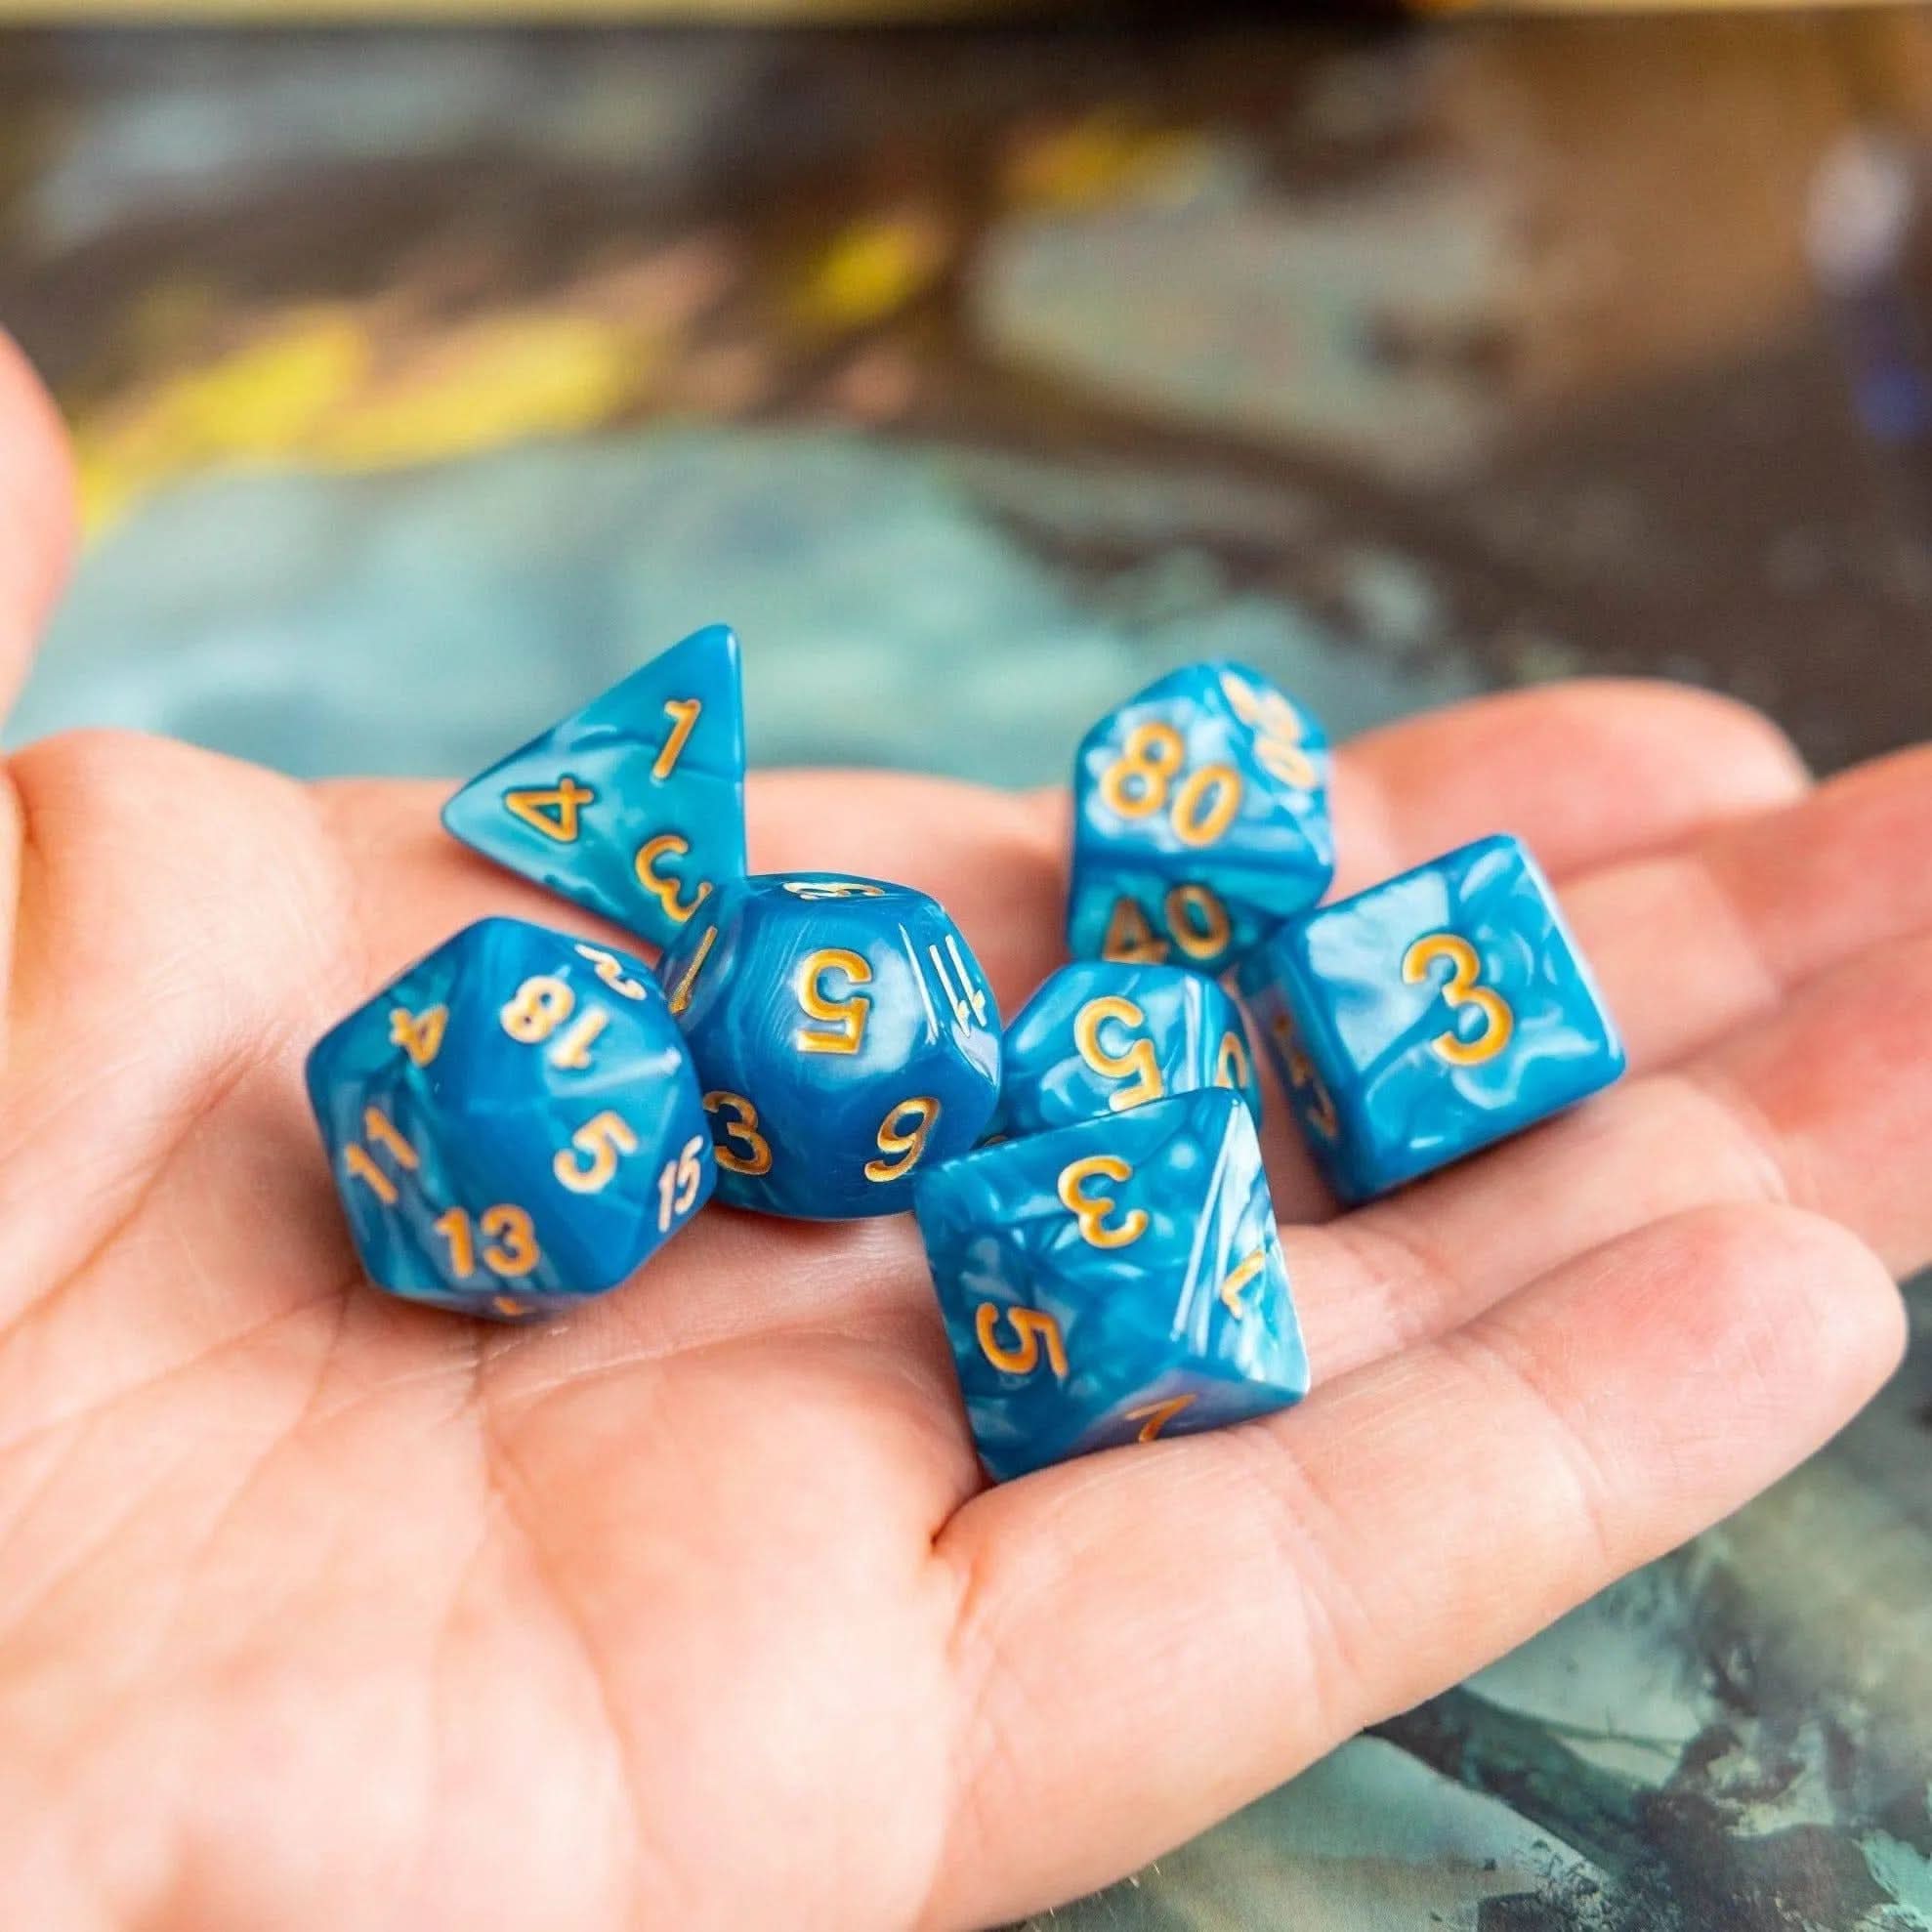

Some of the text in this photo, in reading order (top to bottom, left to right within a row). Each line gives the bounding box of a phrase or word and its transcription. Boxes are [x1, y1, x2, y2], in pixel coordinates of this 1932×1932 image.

[652, 698, 701, 779] 1
[504, 777, 595, 843] 4
[1100, 722, 1242, 846] 80
[636, 835, 713, 922] 3
[390, 1004, 449, 1068] 4
[500, 975, 611, 1071] 18
[798, 947, 872, 1055] 5
[1402, 933, 1514, 1067] 3
[1074, 994, 1166, 1113] 5
[345, 1106, 420, 1204] 11
[554, 1110, 639, 1195] 5
[703, 1090, 773, 1175] 3
[864, 1097, 941, 1183] 9
[657, 1135, 704, 1234] 15
[1057, 1155, 1149, 1250] 3
[434, 1203, 541, 1279] 13
[976, 1301, 1070, 1379] 5
